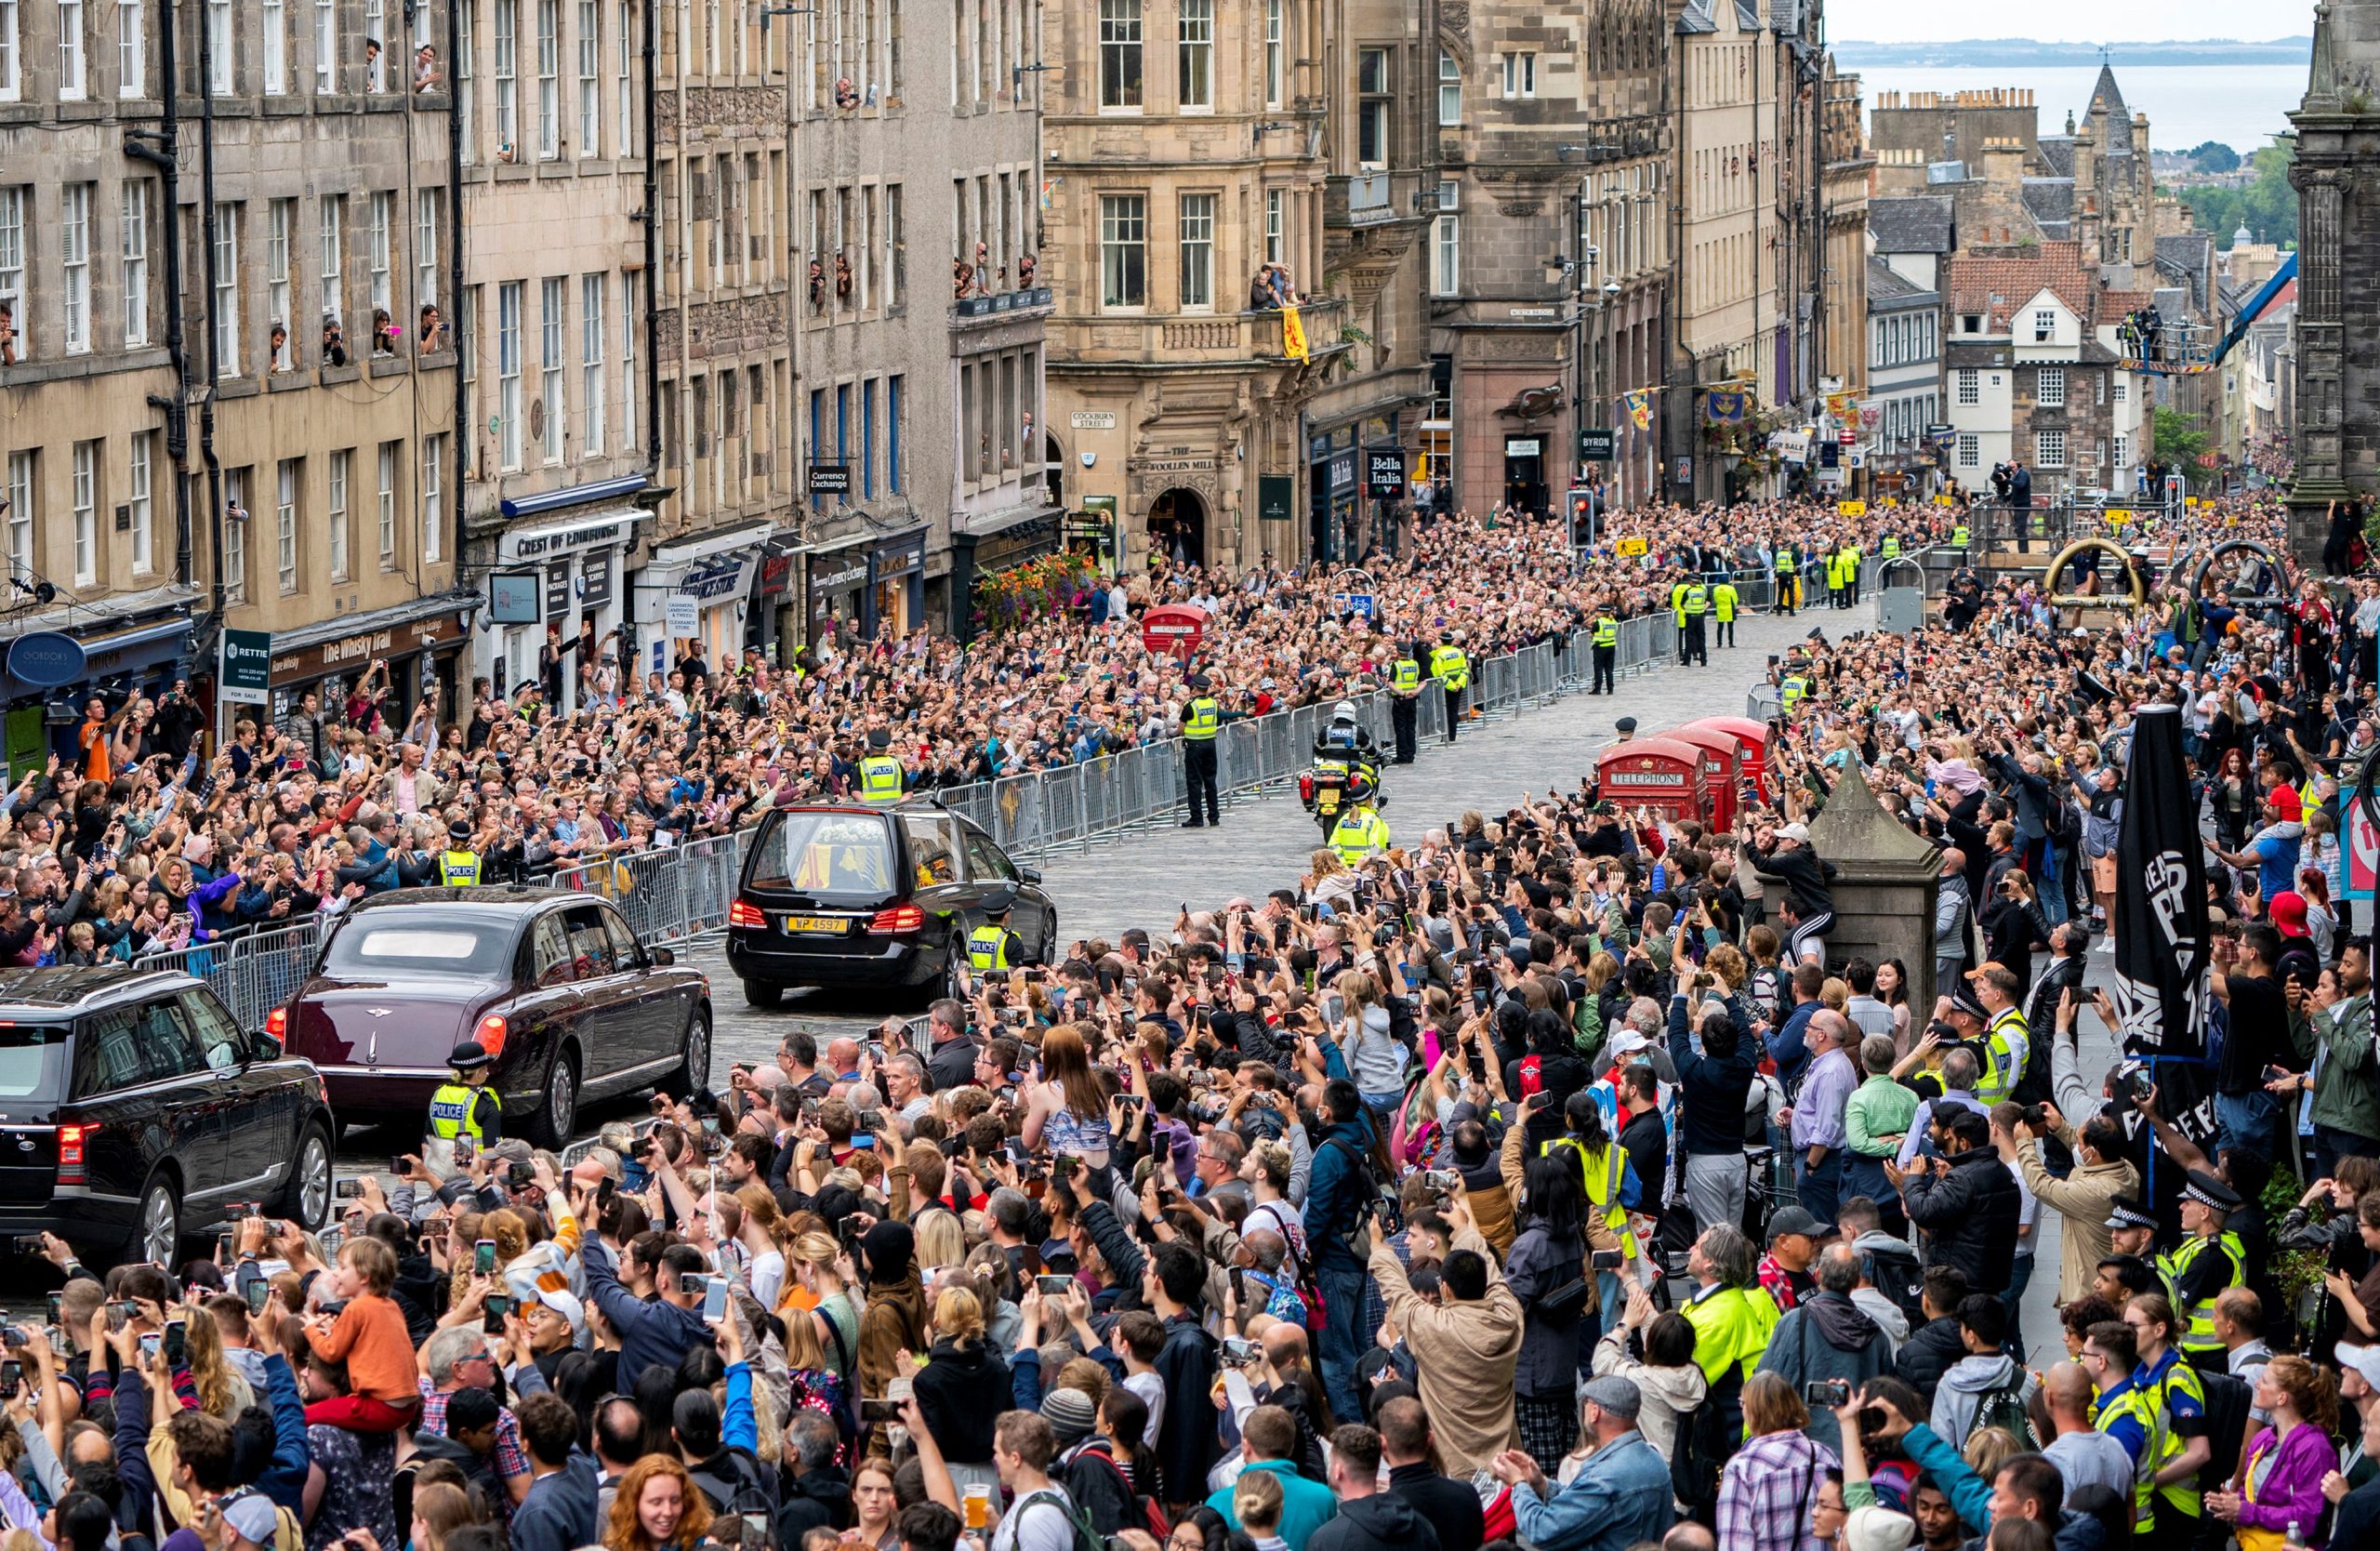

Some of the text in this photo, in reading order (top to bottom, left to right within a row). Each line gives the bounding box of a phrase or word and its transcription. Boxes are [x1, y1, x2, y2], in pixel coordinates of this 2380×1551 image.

[1583, 438, 1609, 446] BYRON
[1786, 443, 1804, 451] SALE
[1171, 447, 1189, 456] THE
[1371, 457, 1401, 470] Bella
[812, 472, 846, 481] Currency
[1371, 471, 1402, 484] Italia
[811, 481, 847, 489] Exchange
[517, 524, 619, 557] CREST OF EDINBURGH
[827, 571, 846, 586] Currency
[847, 565, 866, 580] Exchange
[411, 622, 427, 635] Whisky
[323, 630, 390, 664] The Whisky Trail
[239, 648, 268, 657] RETTIE
[284, 655, 299, 670] Whisky
[1615, 775, 1681, 784] TELEPHONE
[447, 867, 475, 876] POLICE
[796, 919, 840, 930] WP 4597
[970, 942, 995, 952] POLICE
[432, 1104, 462, 1119] POLICE
